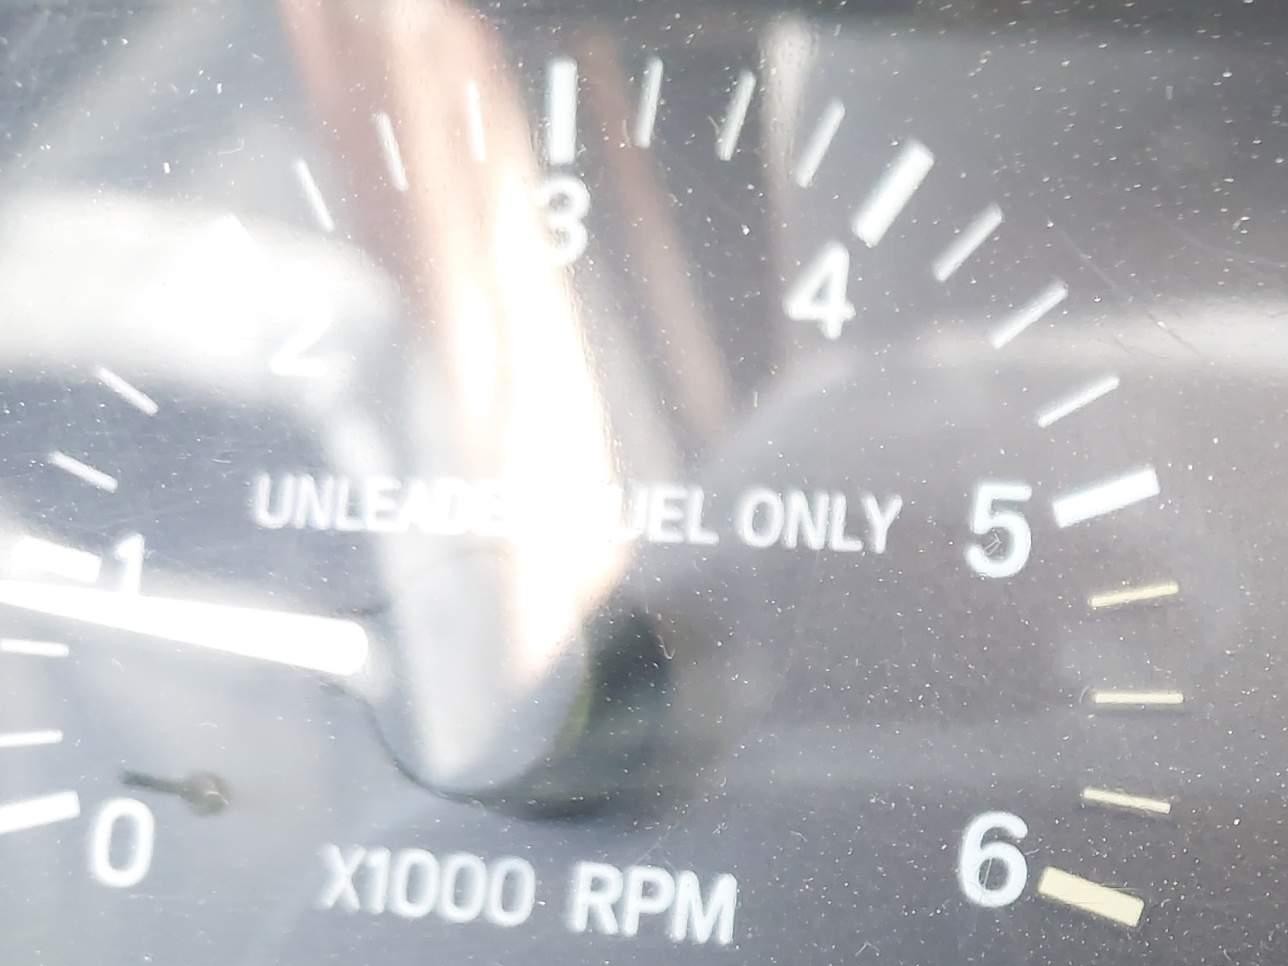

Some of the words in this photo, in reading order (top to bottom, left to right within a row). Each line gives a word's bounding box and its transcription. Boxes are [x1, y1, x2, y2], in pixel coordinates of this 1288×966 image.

[541, 175, 590, 267] 3
[785, 241, 856, 340] 4
[253, 472, 545, 540] UNLEADE
[580, 481, 720, 546] UEL
[735, 487, 903, 555] ONLY
[965, 482, 1033, 578] 5
[113, 532, 146, 594] 1
[90, 799, 155, 888] 0
[958, 811, 1029, 907] 6
[320, 843, 535, 927] X1000
[571, 861, 739, 944] RPM
